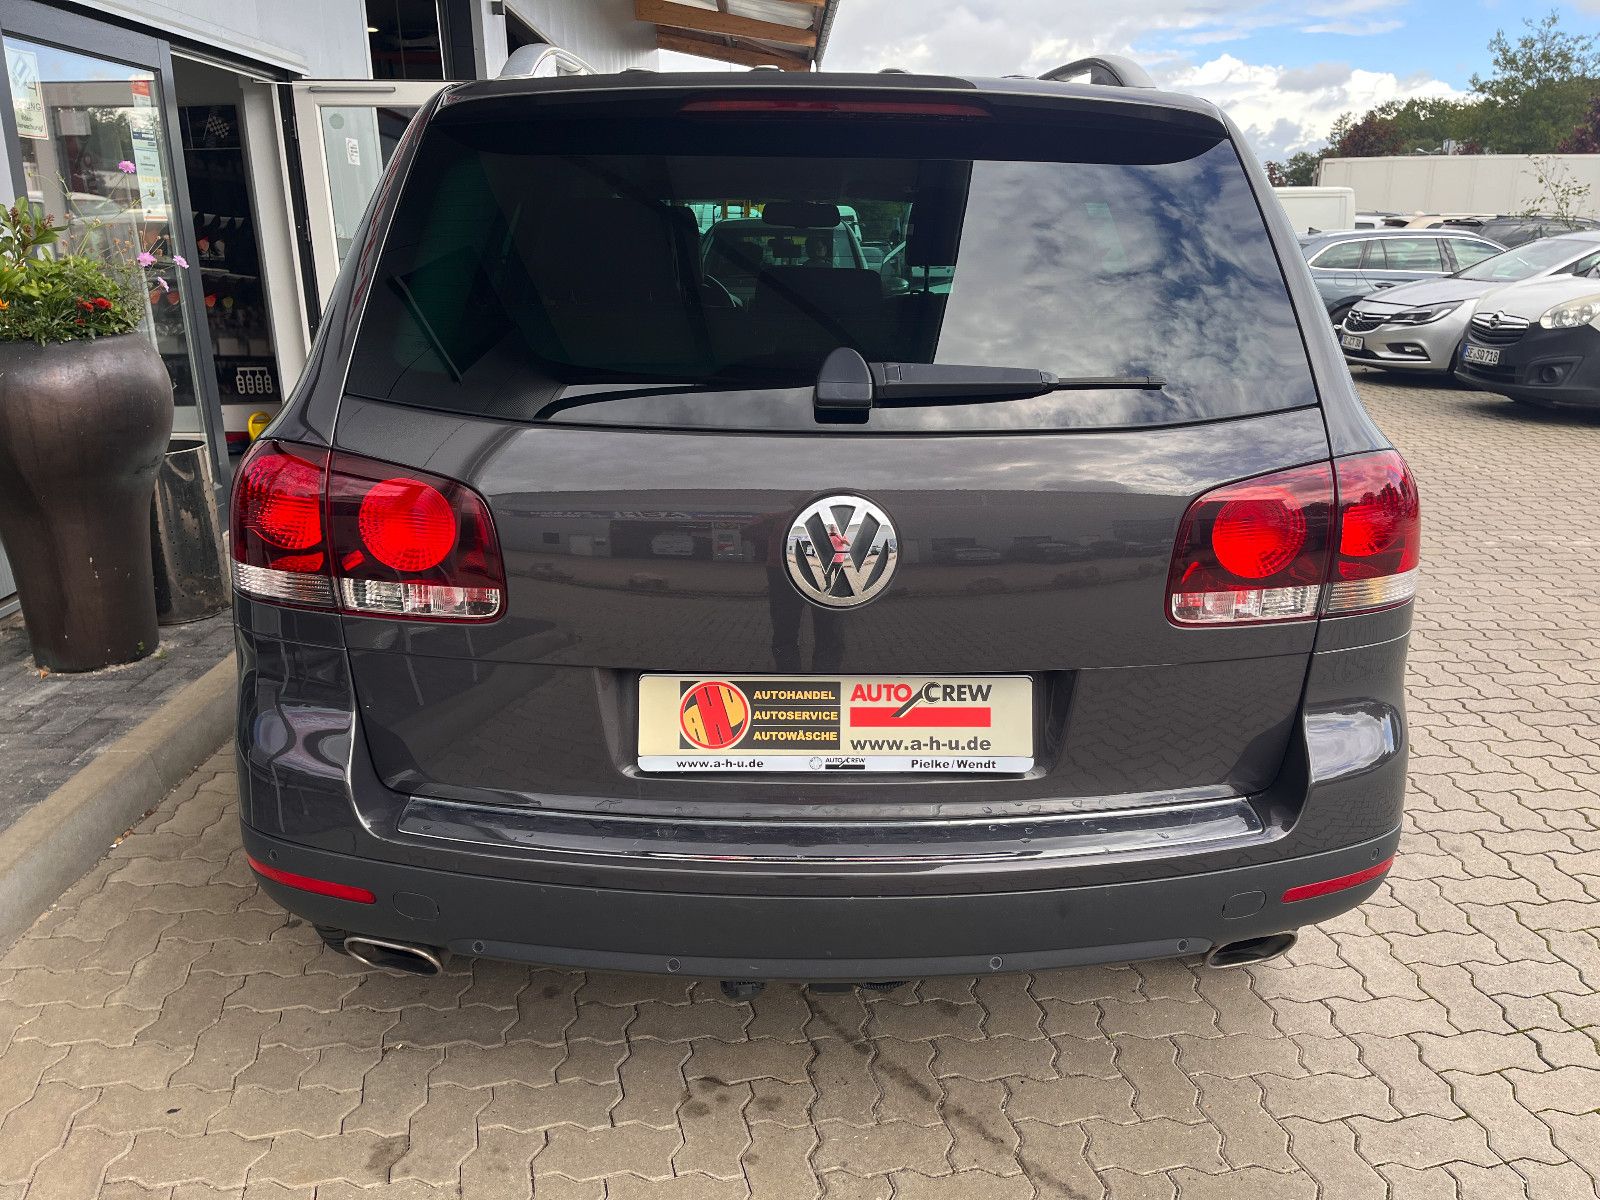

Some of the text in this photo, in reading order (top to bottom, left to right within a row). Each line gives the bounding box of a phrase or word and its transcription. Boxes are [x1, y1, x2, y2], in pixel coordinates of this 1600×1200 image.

[753, 690, 836, 700] AUTOHANDEL
[850, 681, 993, 704] AUTO CREW
[753, 710, 839, 720] AUTOSERVICE
[753, 729, 838, 741] AUTOWÄSCHE
[850, 736, 992, 751] www.a-h-u.de
[676, 758, 764, 769] www.a-h-u.de
